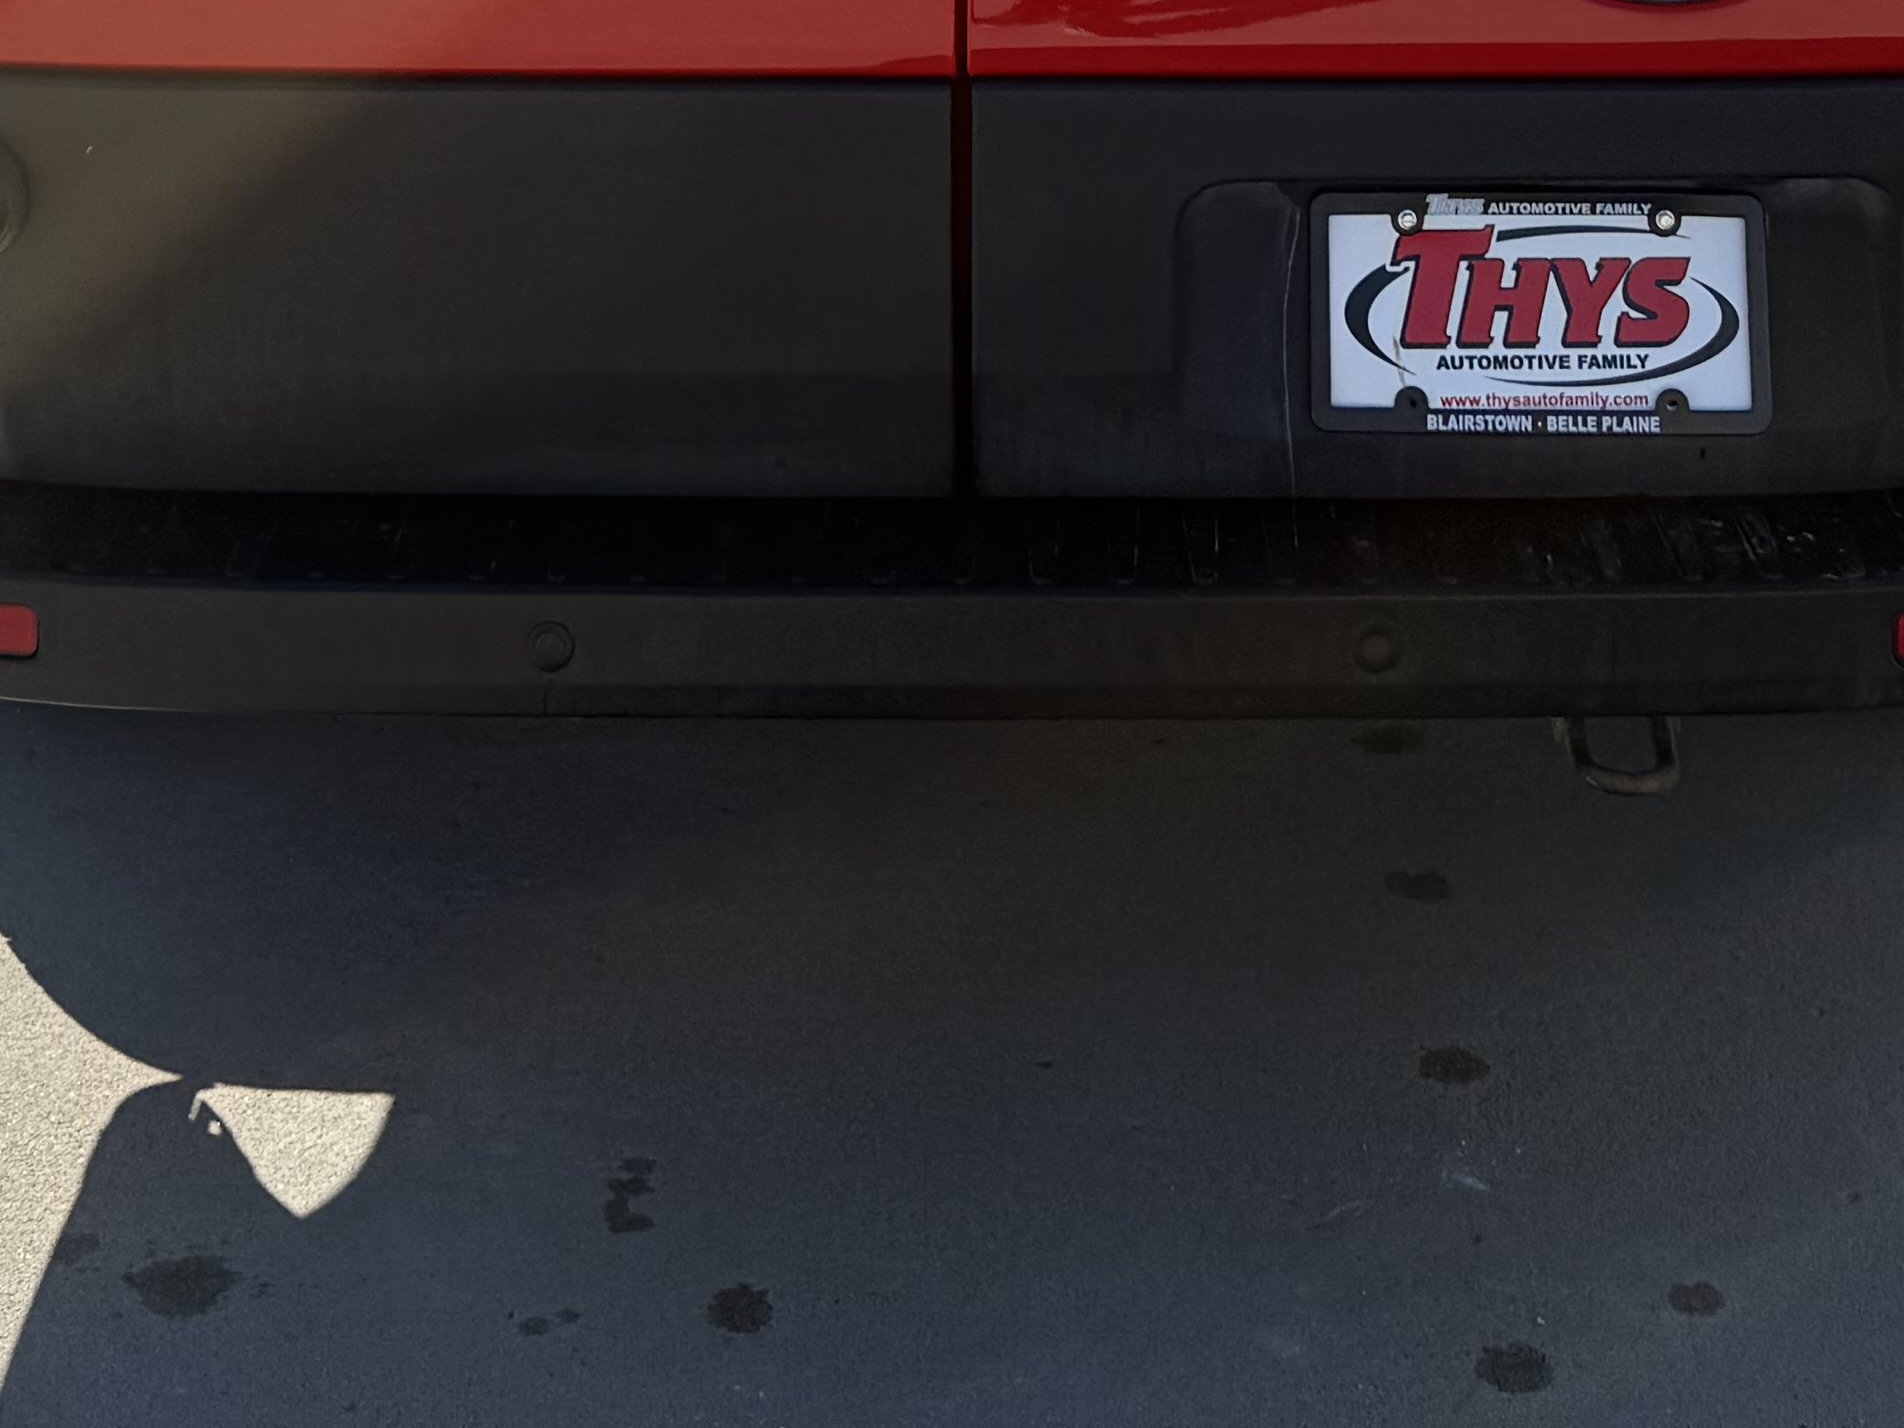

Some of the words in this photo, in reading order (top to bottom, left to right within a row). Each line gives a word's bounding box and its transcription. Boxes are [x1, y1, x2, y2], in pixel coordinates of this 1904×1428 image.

[1487, 202, 1591, 216] AUTOMOTIVE
[1595, 202, 1652, 216] FAMILY
[1389, 223, 1691, 350] THYS
[1435, 353, 1571, 371] AUTOMOTIVE
[1578, 353, 1650, 371] FAMILY
[1440, 391, 1649, 410] www.thysautofamily.com
[1426, 413, 1533, 432] BLAIRSTOWN
[1546, 414, 1597, 432] BELLE
[1601, 415, 1661, 433] PLAINE
